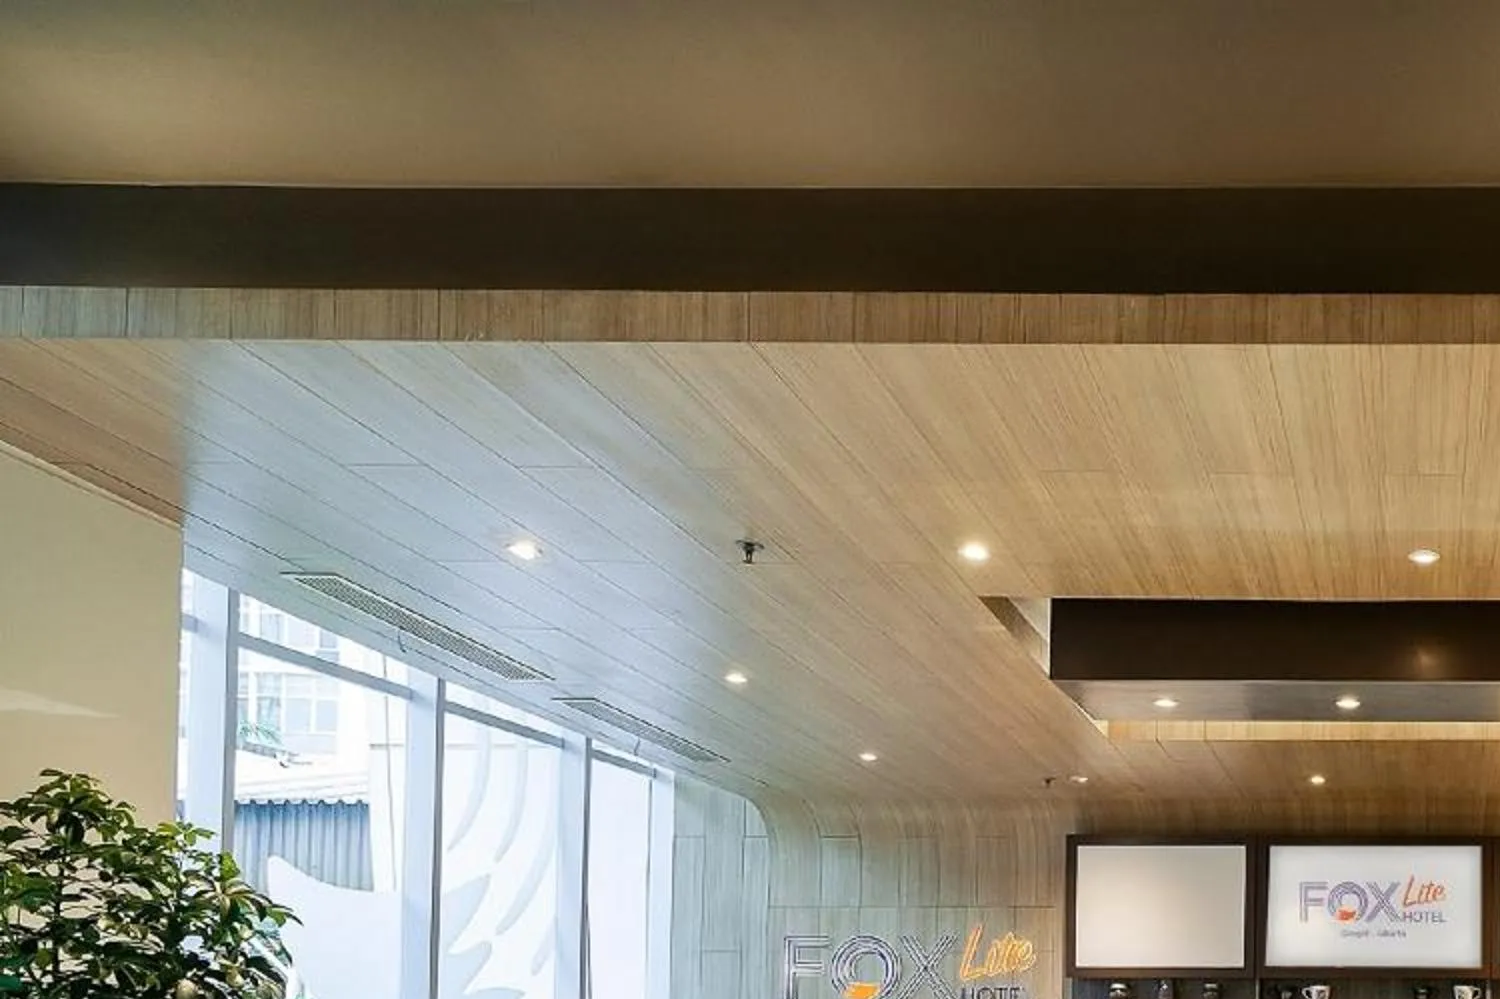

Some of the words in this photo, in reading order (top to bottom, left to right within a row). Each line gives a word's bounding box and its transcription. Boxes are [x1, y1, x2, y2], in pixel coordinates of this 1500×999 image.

[1299, 881, 1401, 923] FOX
[1403, 874, 1447, 908] Lite
[1402, 911, 1447, 923] HOTEL
[958, 923, 1037, 982] Lite
